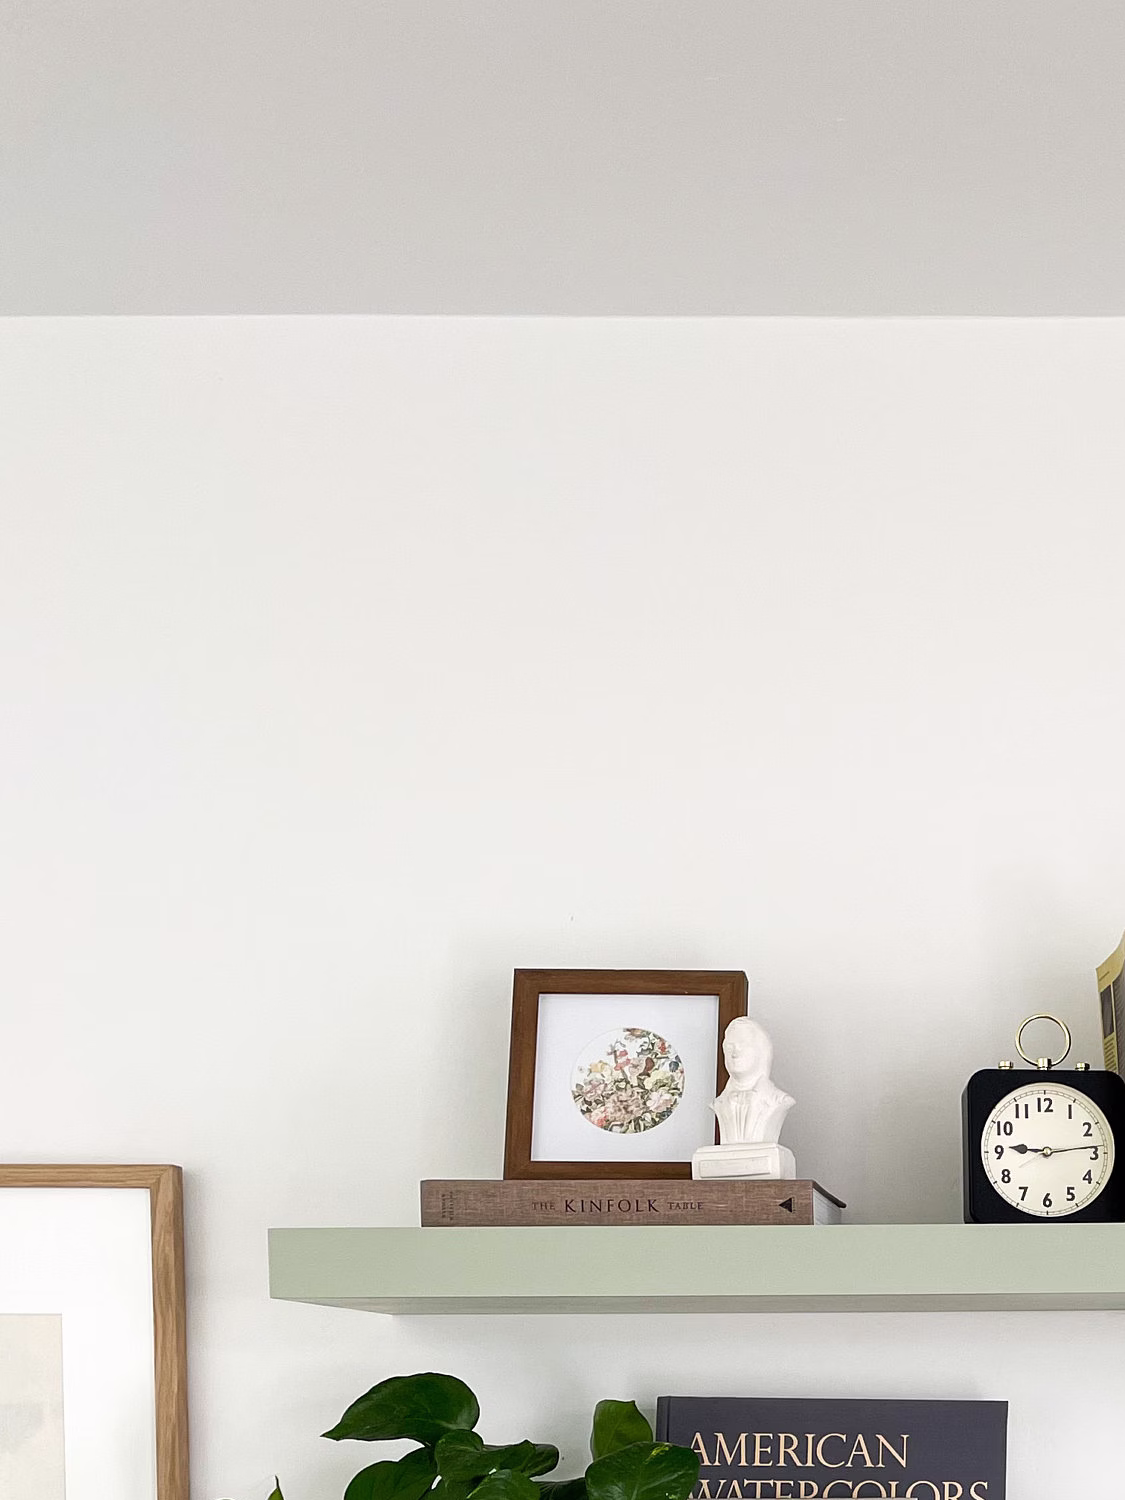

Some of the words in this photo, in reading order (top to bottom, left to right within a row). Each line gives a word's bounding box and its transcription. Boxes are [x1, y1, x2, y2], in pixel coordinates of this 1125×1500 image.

[1015, 1103, 1029, 1119] 11
[1037, 1098, 1054, 1113] 12
[1067, 1104, 1073, 1119] 1
[996, 1121, 1013, 1136] 10
[1082, 1122, 1093, 1137] 2
[994, 1145, 1004, 1160] 9
[1089, 1146, 1099, 1161] 3
[1001, 1169, 1012, 1184] 8
[1082, 1169, 1093, 1184] 4
[1018, 1186, 1029, 1201] 7
[1042, 1193, 1052, 1208] 6
[1066, 1186, 1076, 1202] 5
[532, 1201, 556, 1211] THE
[564, 1198, 660, 1213] KINFOLK
[668, 1201, 703, 1210] TABLE
[689, 1432, 910, 1469] AMERICAN
